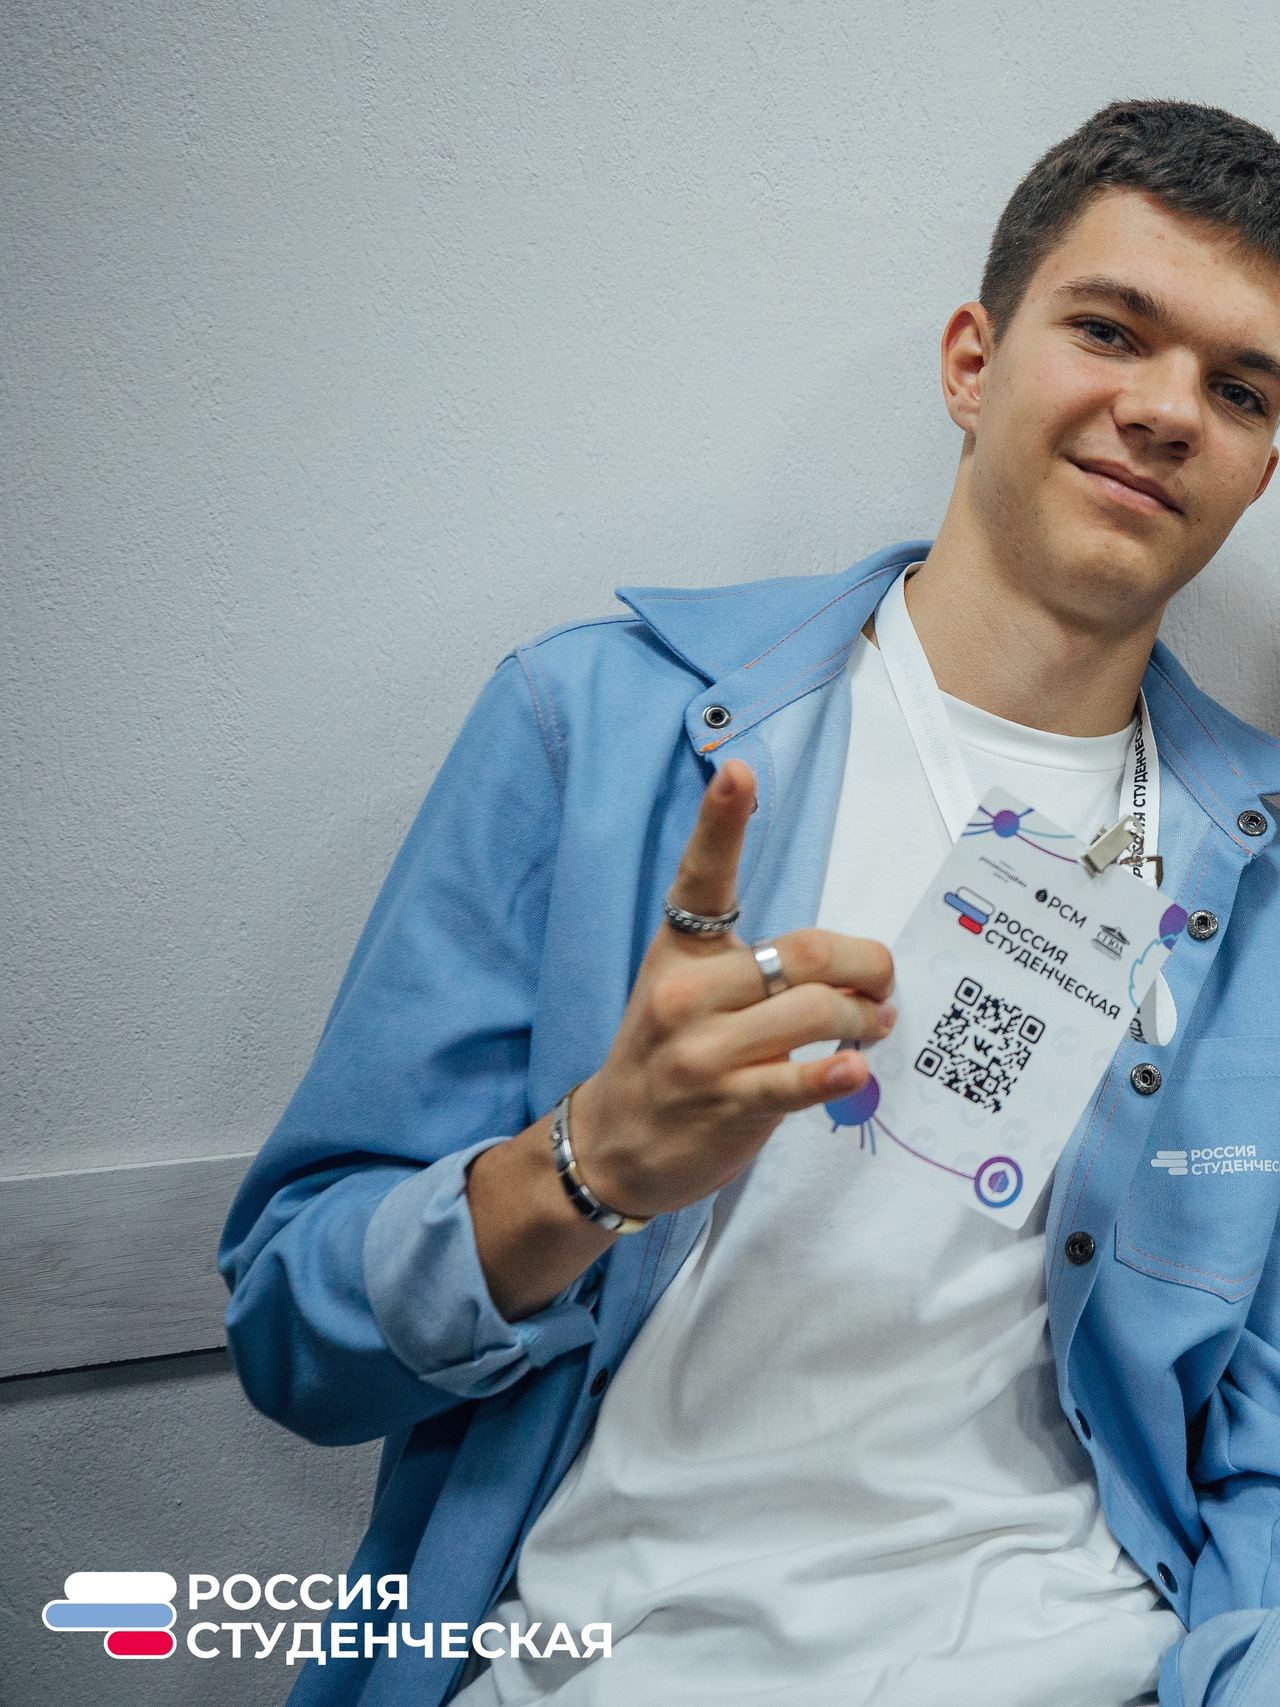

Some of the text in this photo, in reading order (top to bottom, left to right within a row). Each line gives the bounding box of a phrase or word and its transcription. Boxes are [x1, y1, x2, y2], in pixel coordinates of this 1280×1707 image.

[1047, 896, 1088, 929] РСМ
[994, 911, 1069, 965] РОССИЯ
[985, 929, 1121, 1020] СТУДЕНЧЕСКАЯ
[1191, 1145, 1256, 1161] РОССИЯ
